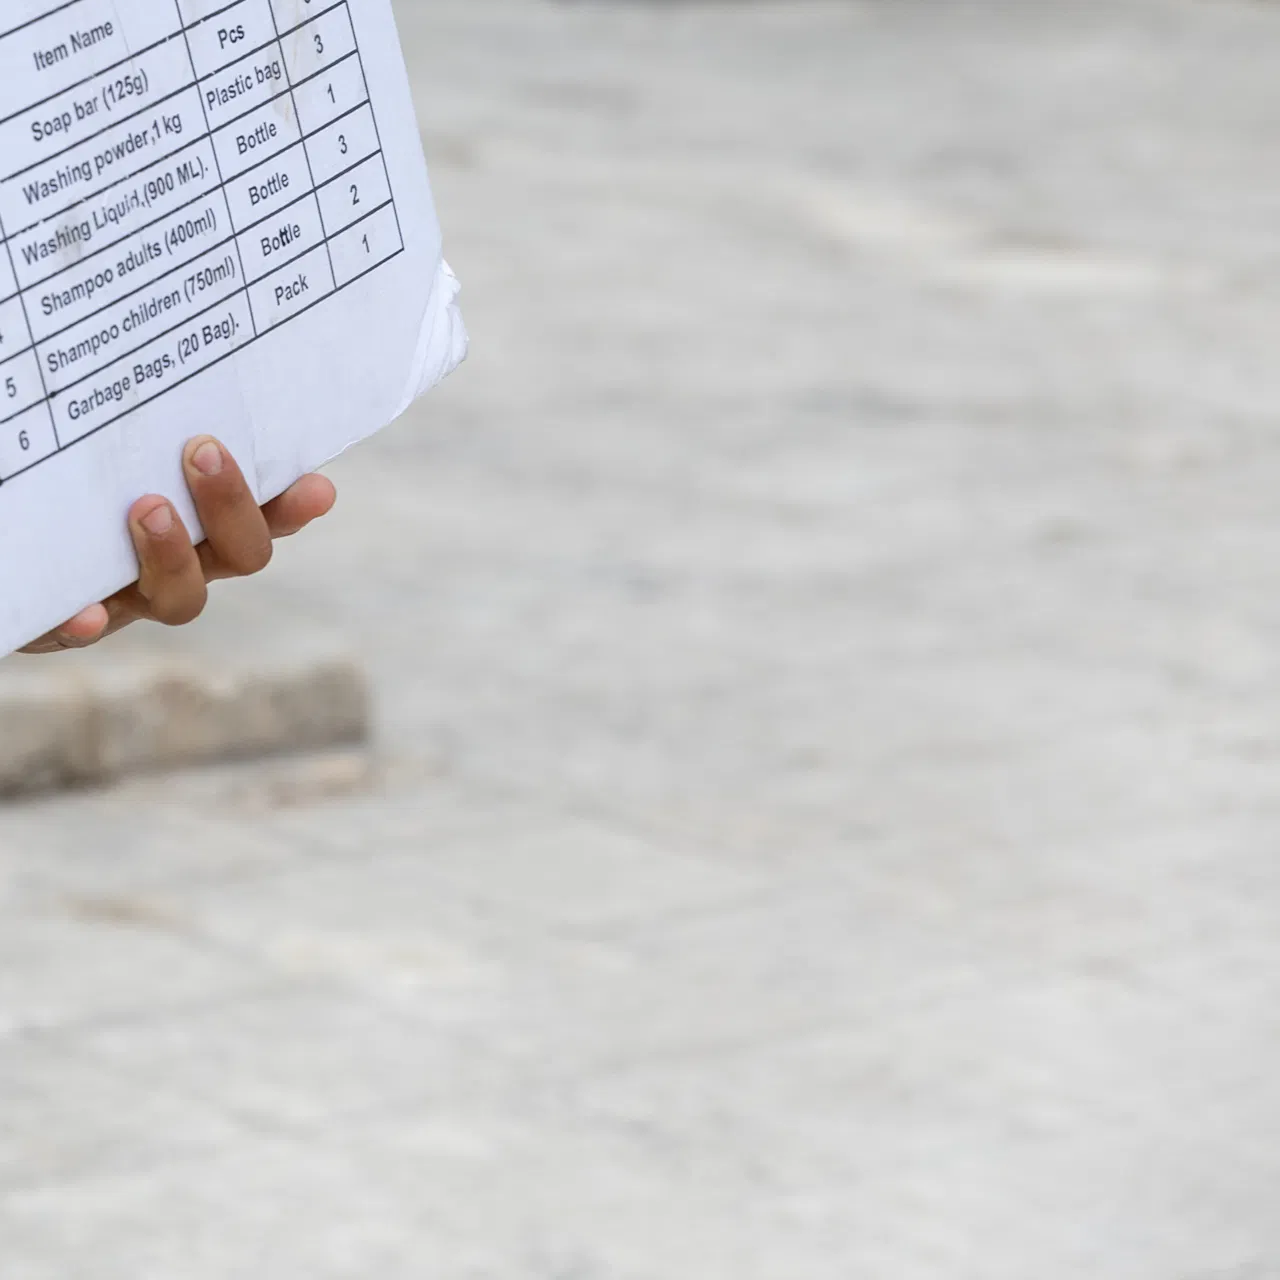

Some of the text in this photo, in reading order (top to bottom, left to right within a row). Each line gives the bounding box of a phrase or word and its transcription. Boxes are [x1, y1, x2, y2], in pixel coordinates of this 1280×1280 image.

[21, 159, 94, 206] Washing
[161, 113, 183, 135] kg
[205, 74, 254, 112] Plastic
[253, 59, 282, 85] bag
[313, 33, 325, 55] 3
[30, 111, 73, 143] Soap
[72, 96, 99, 122] bar
[101, 67, 149, 112] (125g)
[216, 24, 246, 50] Pcs
[32, 42, 70, 72] Item
[68, 20, 114, 54] Name
[20, 220, 93, 266] Washing
[235, 121, 278, 156] Bottle
[326, 82, 336, 104] 1
[40, 267, 115, 317] Shampoo
[115, 241, 163, 278] adults
[164, 207, 217, 256] (400ml)
[247, 171, 290, 207] Bottle
[337, 133, 348, 155] 3
[4, 183, 361, 399] 5 Shampoo children (750ml) Bottle 2
[18, 429, 31, 452] 6
[67, 375, 132, 421] Garbage
[132, 353, 176, 385] Bags,
[177, 332, 200, 365] (20
[273, 273, 310, 307] Pack
[361, 233, 371, 254] 1
